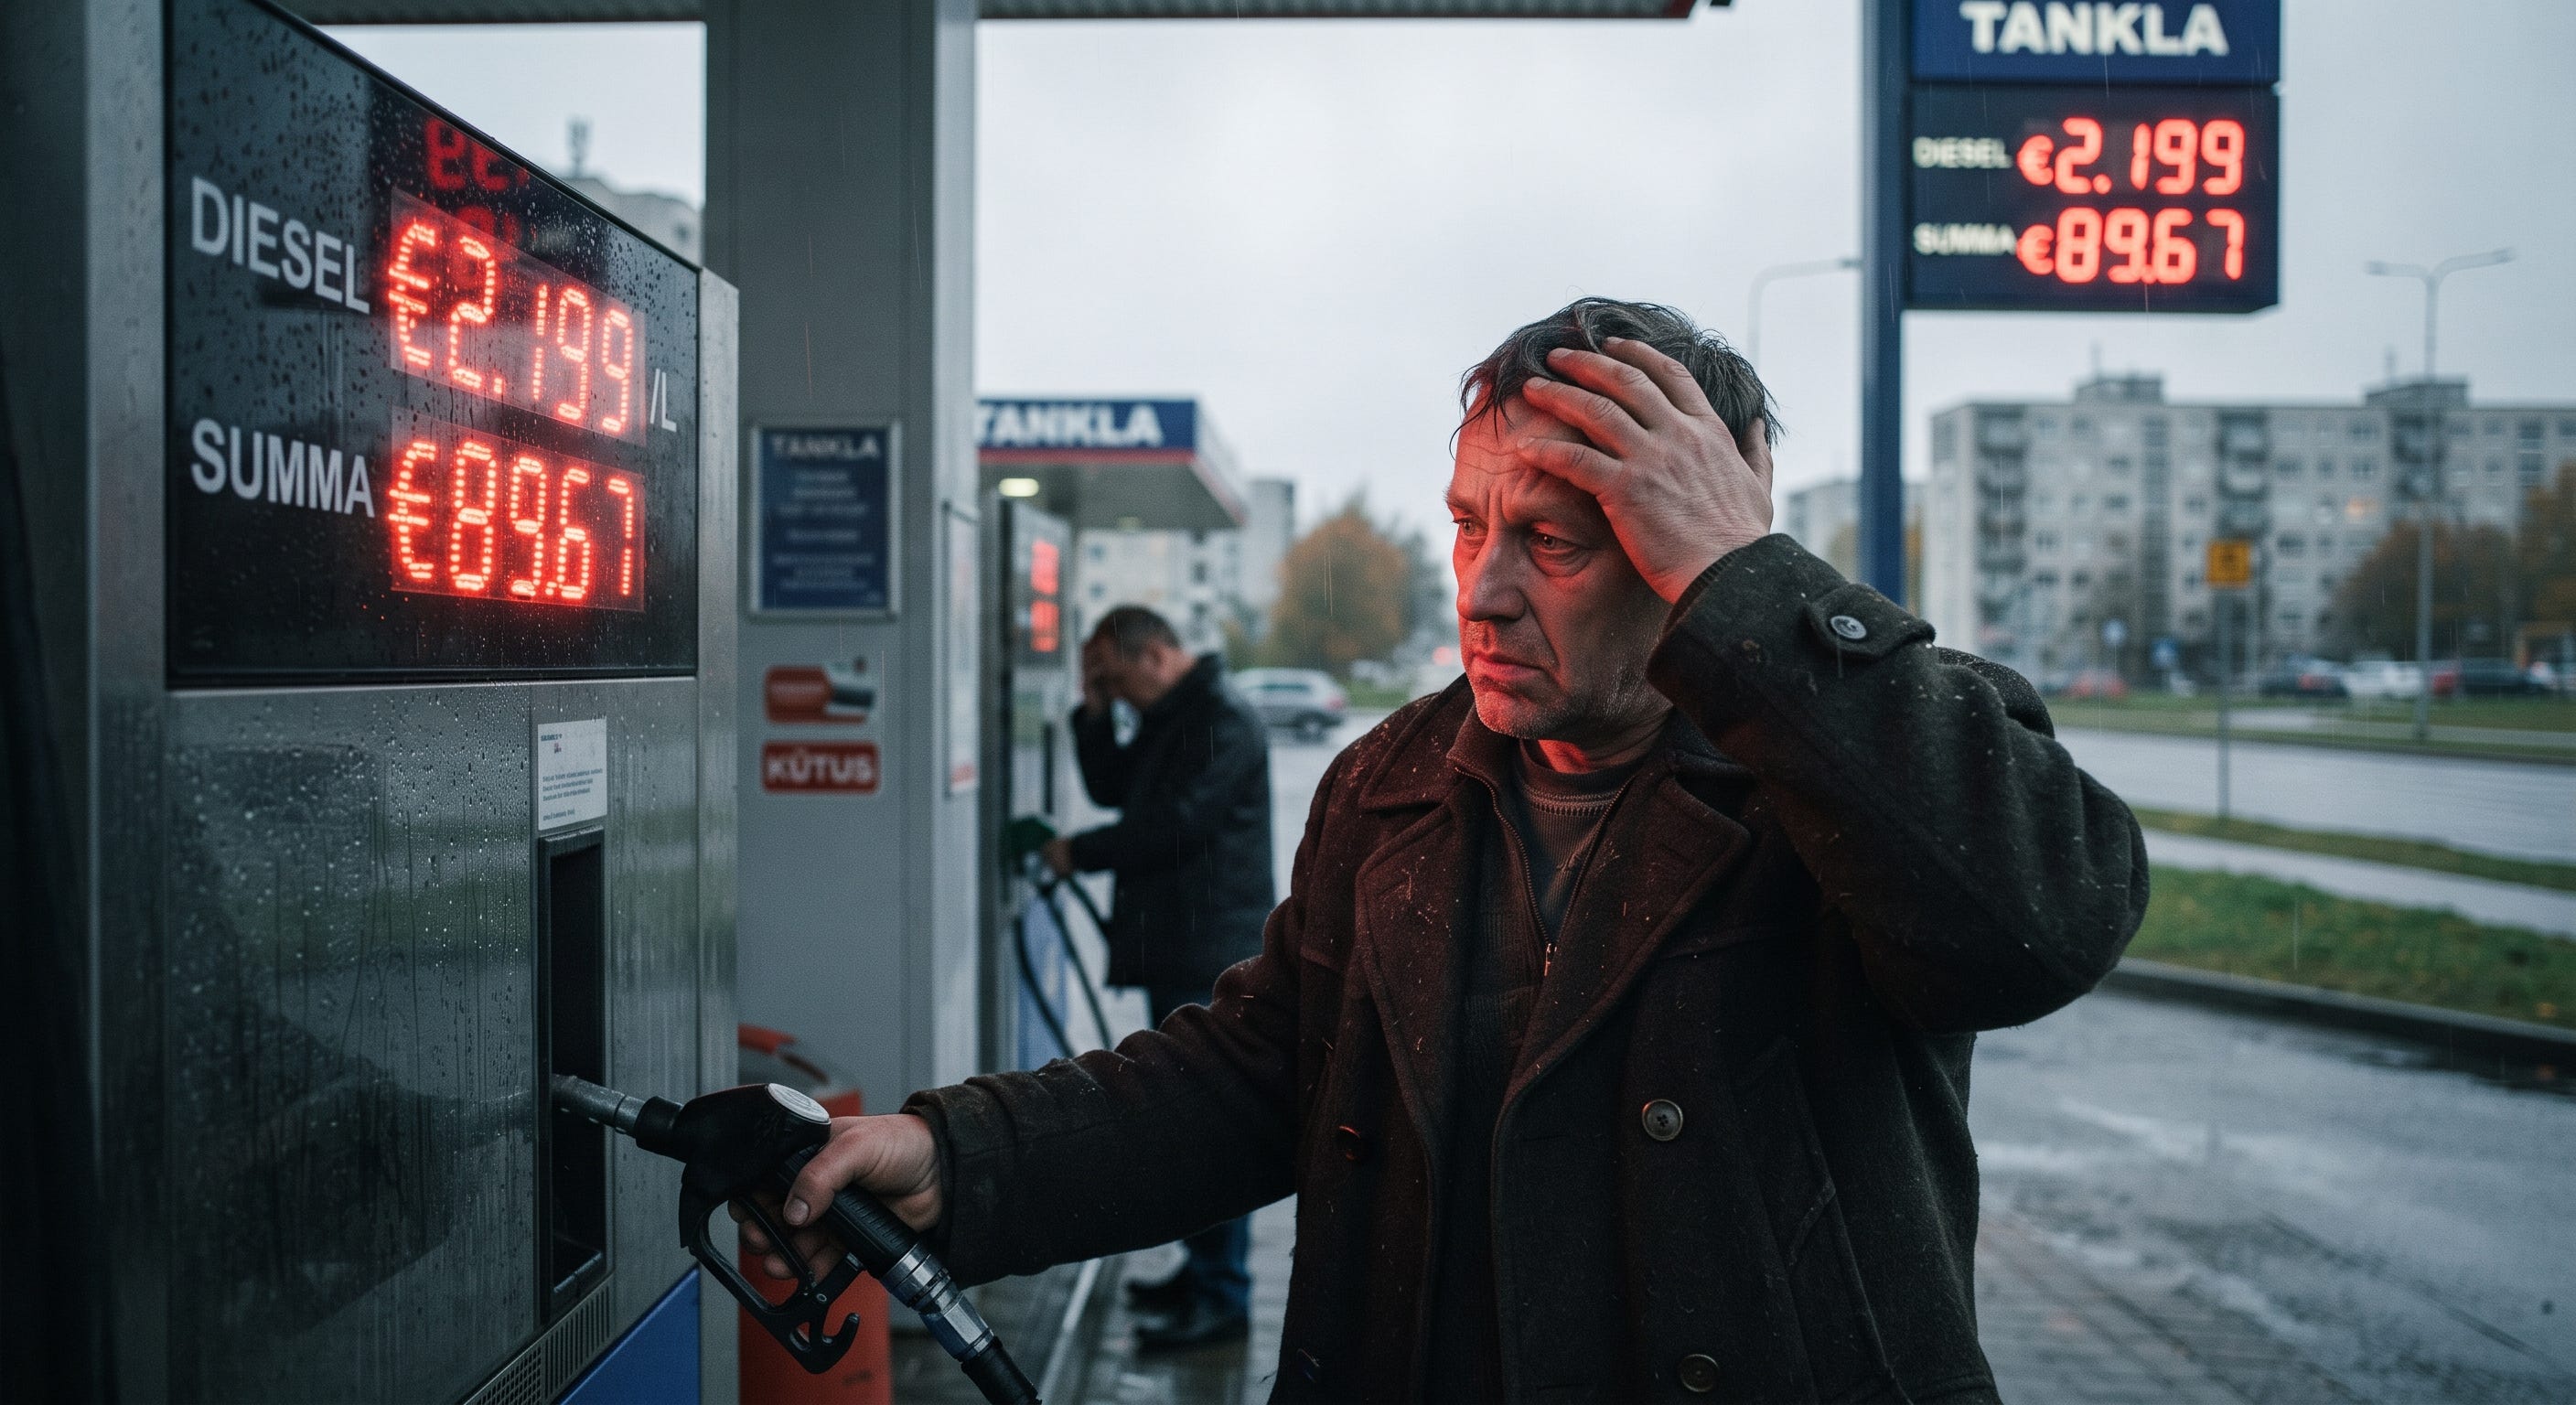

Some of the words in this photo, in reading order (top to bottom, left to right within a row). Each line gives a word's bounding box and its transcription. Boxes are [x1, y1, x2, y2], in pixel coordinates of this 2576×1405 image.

[1959, 2, 2228, 56] TANKLA
[1913, 136, 2011, 168] DIESEL
[2017, 117, 2245, 195] €2.199
[1914, 223, 2017, 255] SUMMA
[191, 177, 370, 315] DIESEL
[388, 218, 633, 434] €2.199
[649, 369, 677, 433] /L
[191, 418, 375, 518] SUMMA
